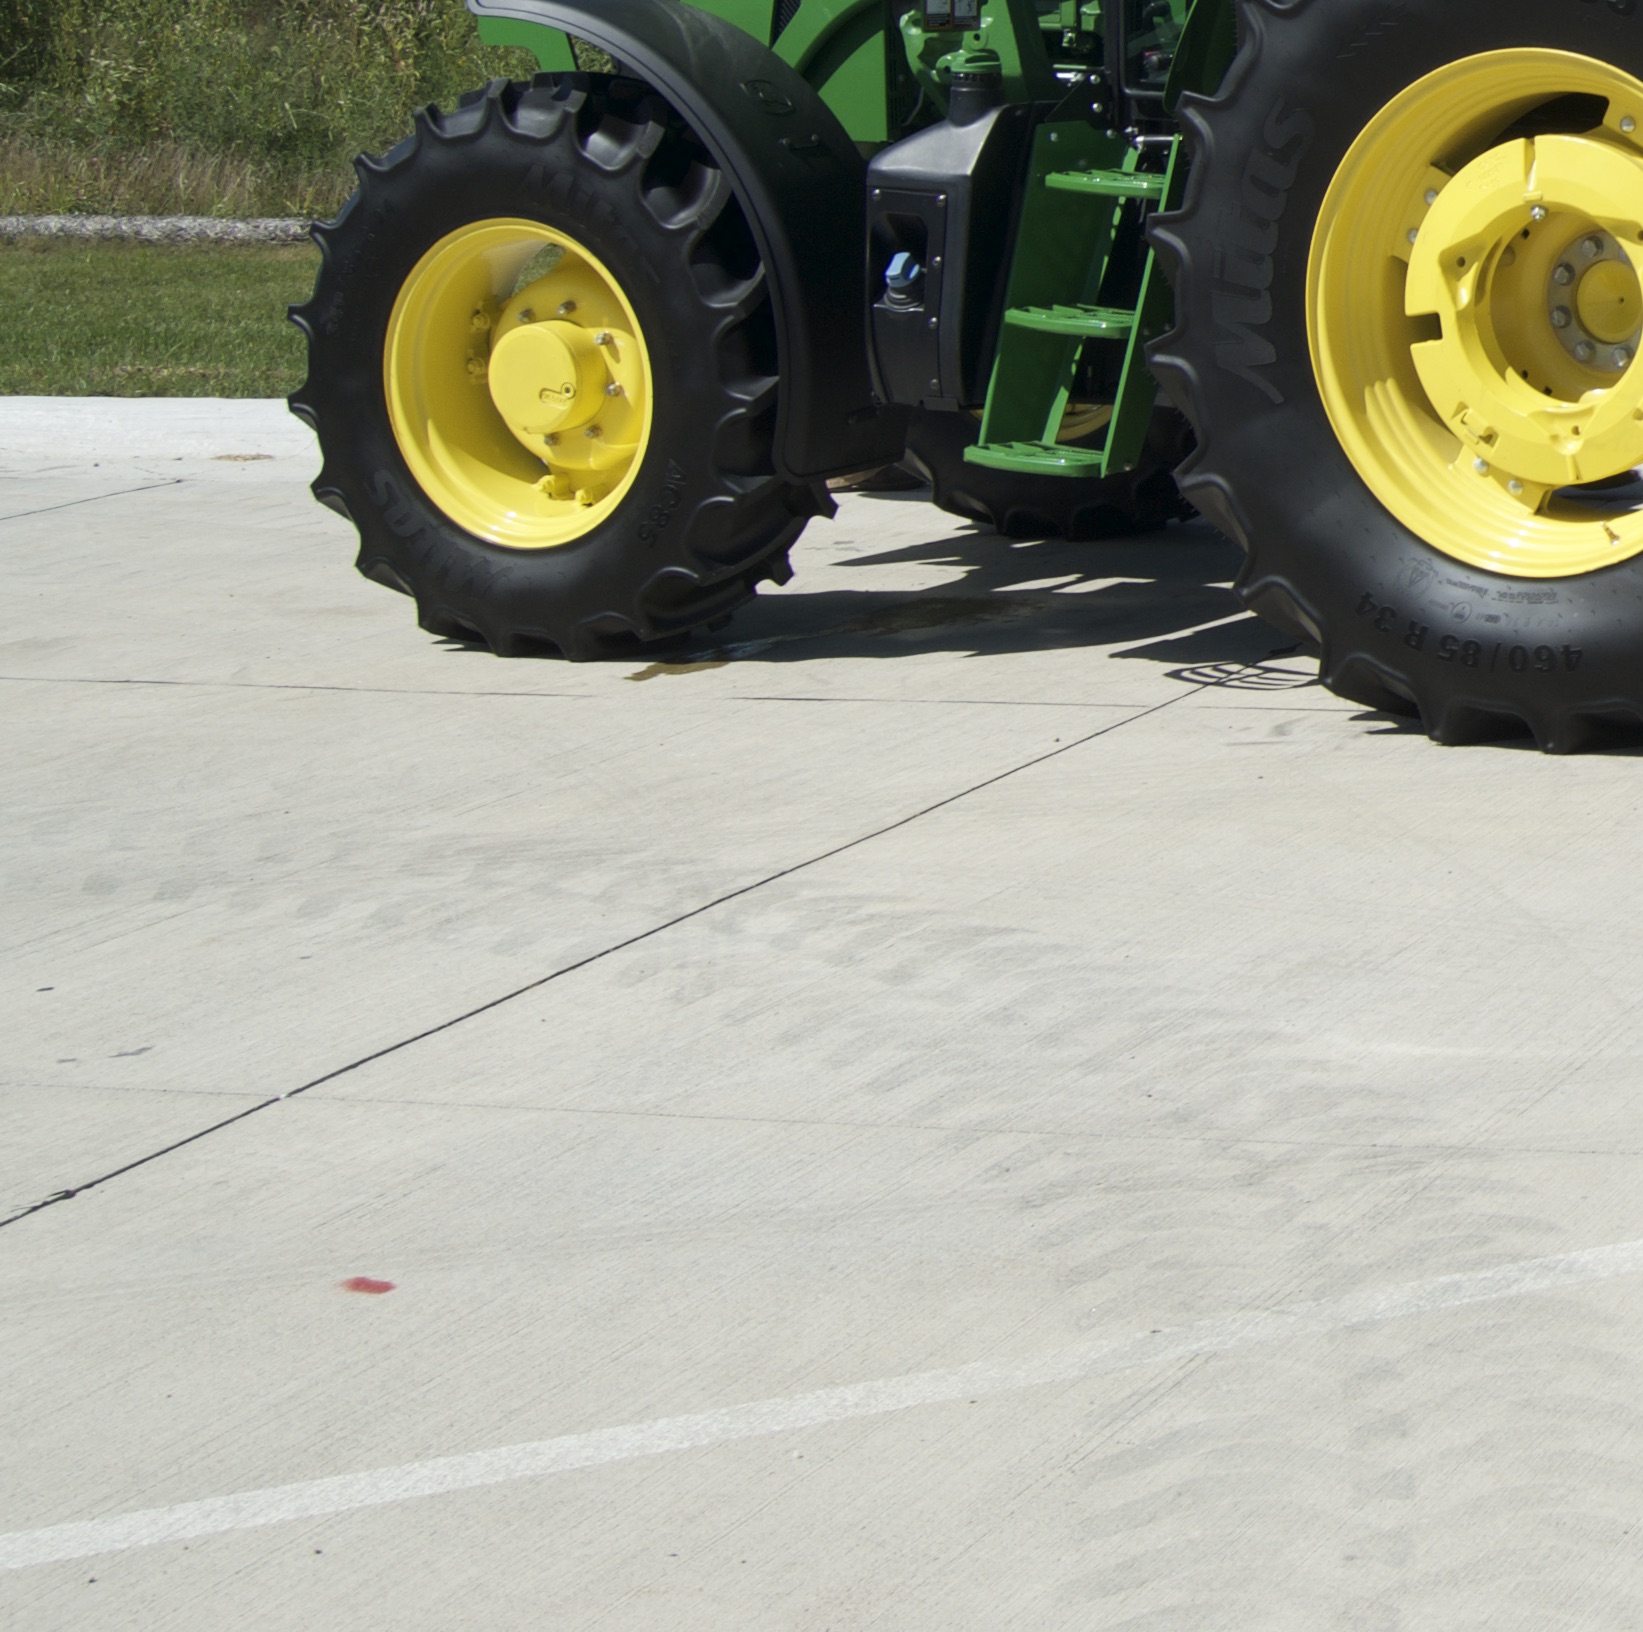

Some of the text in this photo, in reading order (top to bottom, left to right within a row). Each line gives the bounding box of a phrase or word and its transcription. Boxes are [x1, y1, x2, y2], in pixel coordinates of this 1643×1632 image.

[1355, 590, 1398, 633] 34
[1403, 620, 1430, 651] R
[1436, 633, 1584, 673] 460/85
